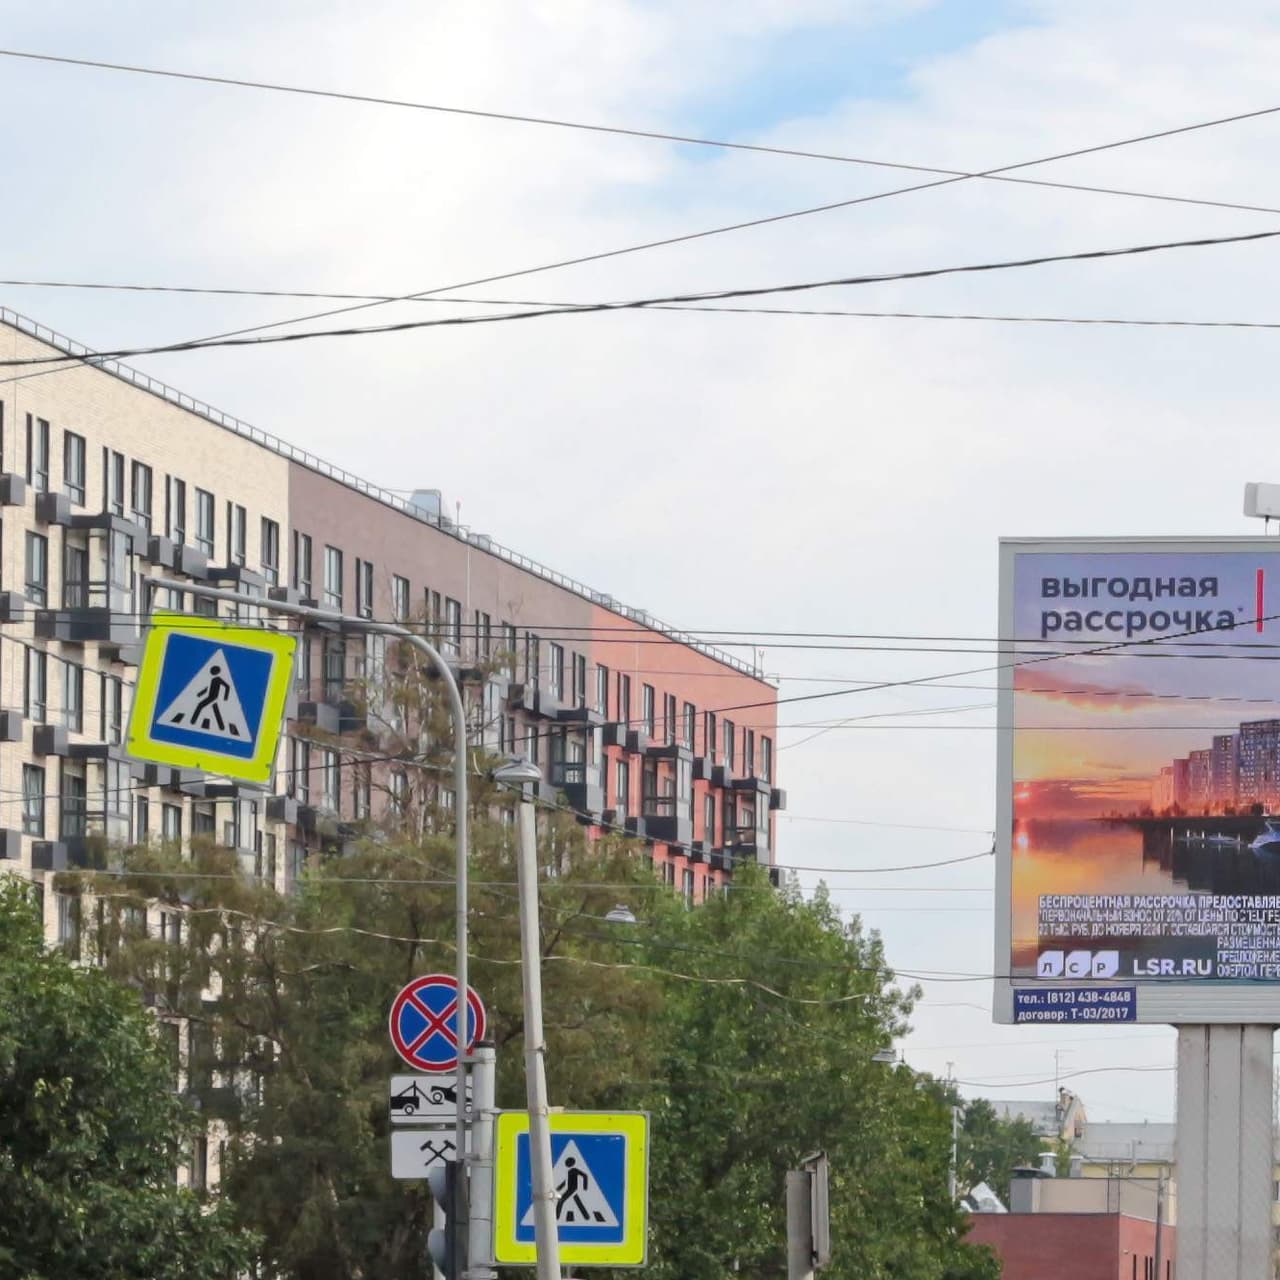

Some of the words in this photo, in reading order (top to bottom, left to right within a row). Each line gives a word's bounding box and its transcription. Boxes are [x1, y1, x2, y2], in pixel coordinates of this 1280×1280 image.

[1041, 576, 1218, 600] выгодная
[1039, 896, 1131, 909] БЕСПРОЦЕНТНАЯ
[1134, 896, 1196, 909] РАССРОЧКА
[1133, 959, 1212, 975] LSR.RU
[1017, 993, 1044, 1004] тел.:
[1047, 991, 1075, 1004] (812)
[1077, 991, 1131, 1003] 438-4848
[1017, 1010, 1068, 1021] договор:
[1070, 1007, 1129, 1020] Т-03/2017
